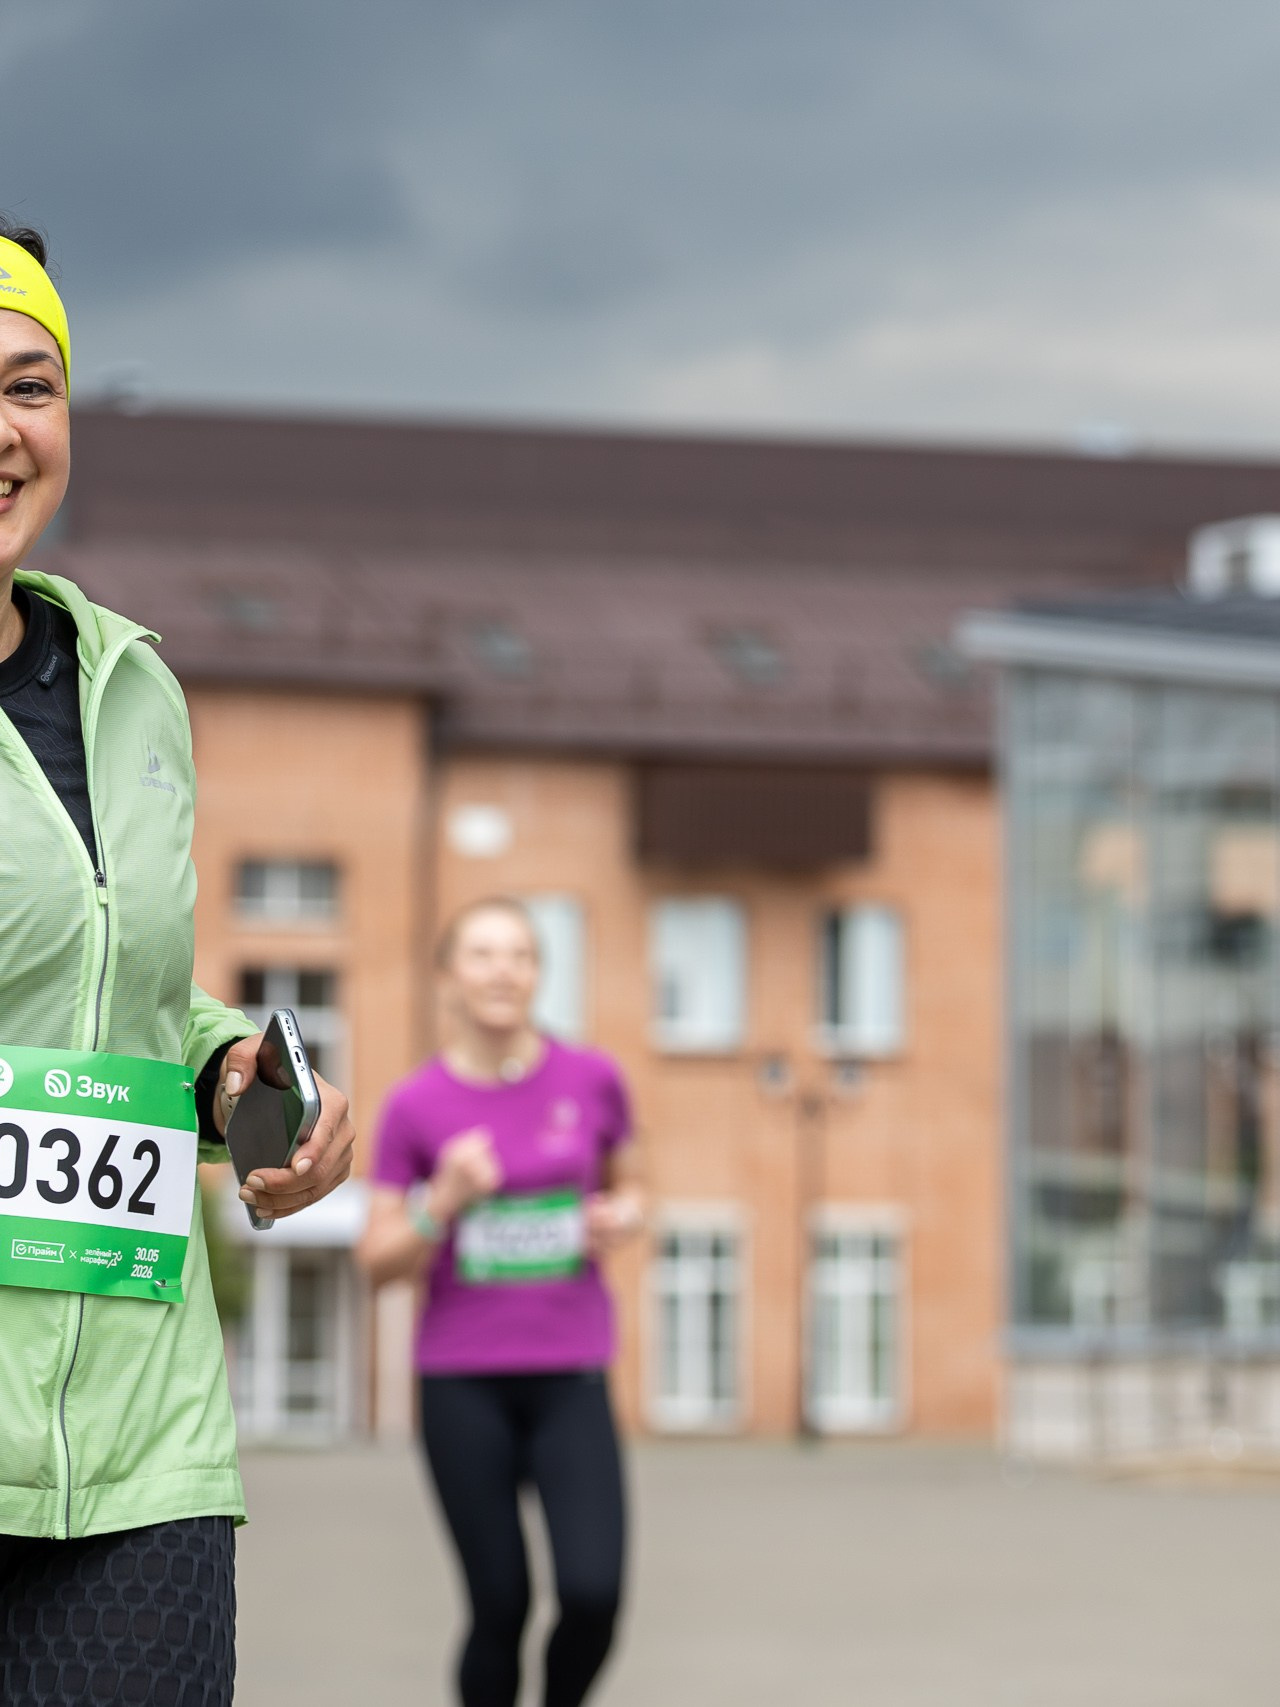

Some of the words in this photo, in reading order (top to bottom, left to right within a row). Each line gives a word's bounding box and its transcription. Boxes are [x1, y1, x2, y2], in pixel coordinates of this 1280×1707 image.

[76, 1075, 130, 1103] Звук
[27, 1246, 58, 1257] Прайм
[84, 1249, 112, 1257] зелёный
[134, 1247, 160, 1263] 30.05
[80, 1256, 109, 1266] марафон
[130, 1264, 153, 1279] 2026
